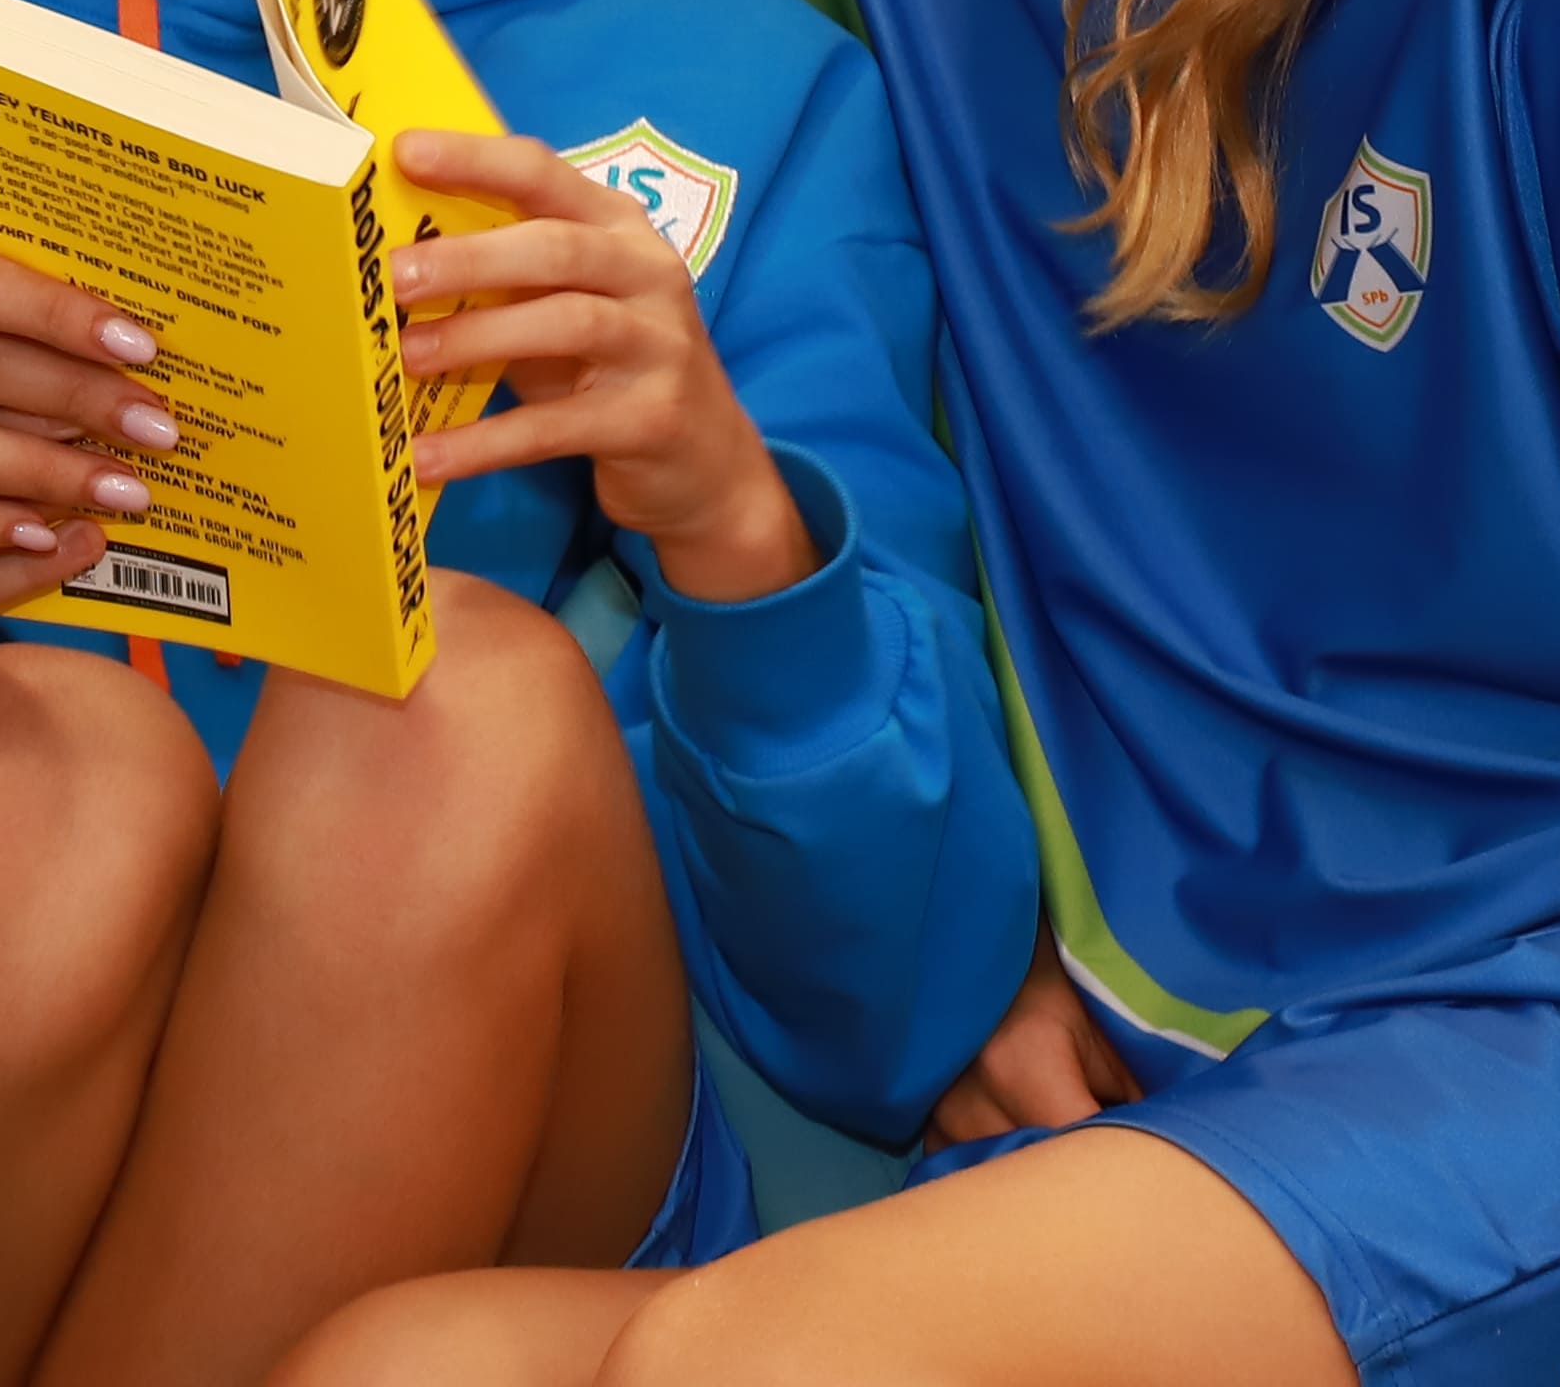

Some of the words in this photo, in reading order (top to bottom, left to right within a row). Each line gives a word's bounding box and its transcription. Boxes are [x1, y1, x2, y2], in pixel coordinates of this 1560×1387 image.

[27, 102, 113, 147] YELNATS
[120, 138, 160, 165] HAS
[167, 156, 208, 183] BAD
[214, 173, 266, 205] LUCK
[1, 161, 58, 191] detention
[62, 184, 100, 206] centre
[104, 199, 117, 213] at
[122, 206, 154, 228] Camp
[158, 220, 191, 241] Green
[194, 233, 222, 253] Lake
[6, 175, 26, 192] and
[76, 201, 101, 219] have
[105, 213, 112, 223] a
[153, 230, 167, 245] he
[171, 238, 192, 254] and
[196, 247, 213, 263] his
[217, 256, 283, 289] campmates
[56, 167, 76, 184] bad
[80, 176, 103, 194] luck
[108, 187, 154, 215] unfairly
[158, 206, 188, 227] lands
[192, 219, 213, 237] him
[217, 229, 229, 242] in
[232, 235, 253, 252] the
[1340, 184, 1382, 236] IS
[14, 204, 28, 218] to
[32, 210, 49, 226] dig
[53, 218, 84, 238] holes
[88, 231, 98, 243] in
[102, 236, 133, 257] order
[138, 250, 152, 264] to
[155, 256, 183, 276] build
[187, 269, 240, 298] character
[130, 234, 172, 259] Magnet
[177, 253, 198, 270] and
[202, 262, 240, 287] Zigzag
[245, 279, 263, 294] are
[352, 161, 385, 320] holes
[39, 237, 70, 257] ARE
[75, 250, 113, 273] THEY
[118, 266, 171, 295] REALLY
[176, 288, 237, 321] DIGGING
[241, 313, 282, 338] FOR?
[81, 280, 109, 299] total
[157, 358, 209, 386] detective
[209, 364, 235, 384] book
[240, 376, 264, 396] that
[174, 398, 194, 413] one
[199, 406, 228, 426] false
[174, 409, 236, 441] SUNDAY
[375, 353, 407, 472] LOUIS
[135, 465, 190, 493] TIONAL
[194, 483, 234, 507] BOOK
[240, 499, 296, 530] AWARD
[138, 452, 215, 487] NEWBERY
[219, 479, 270, 507] MEDAL
[121, 508, 146, 527] AND
[149, 515, 200, 542] READING
[203, 530, 243, 553] GROUP
[247, 544, 284, 567] NOTES
[146, 500, 194, 525] ATERIAL
[198, 516, 232, 537] FROM
[234, 528, 254, 544] THE
[387, 466, 426, 628] SACHAR
